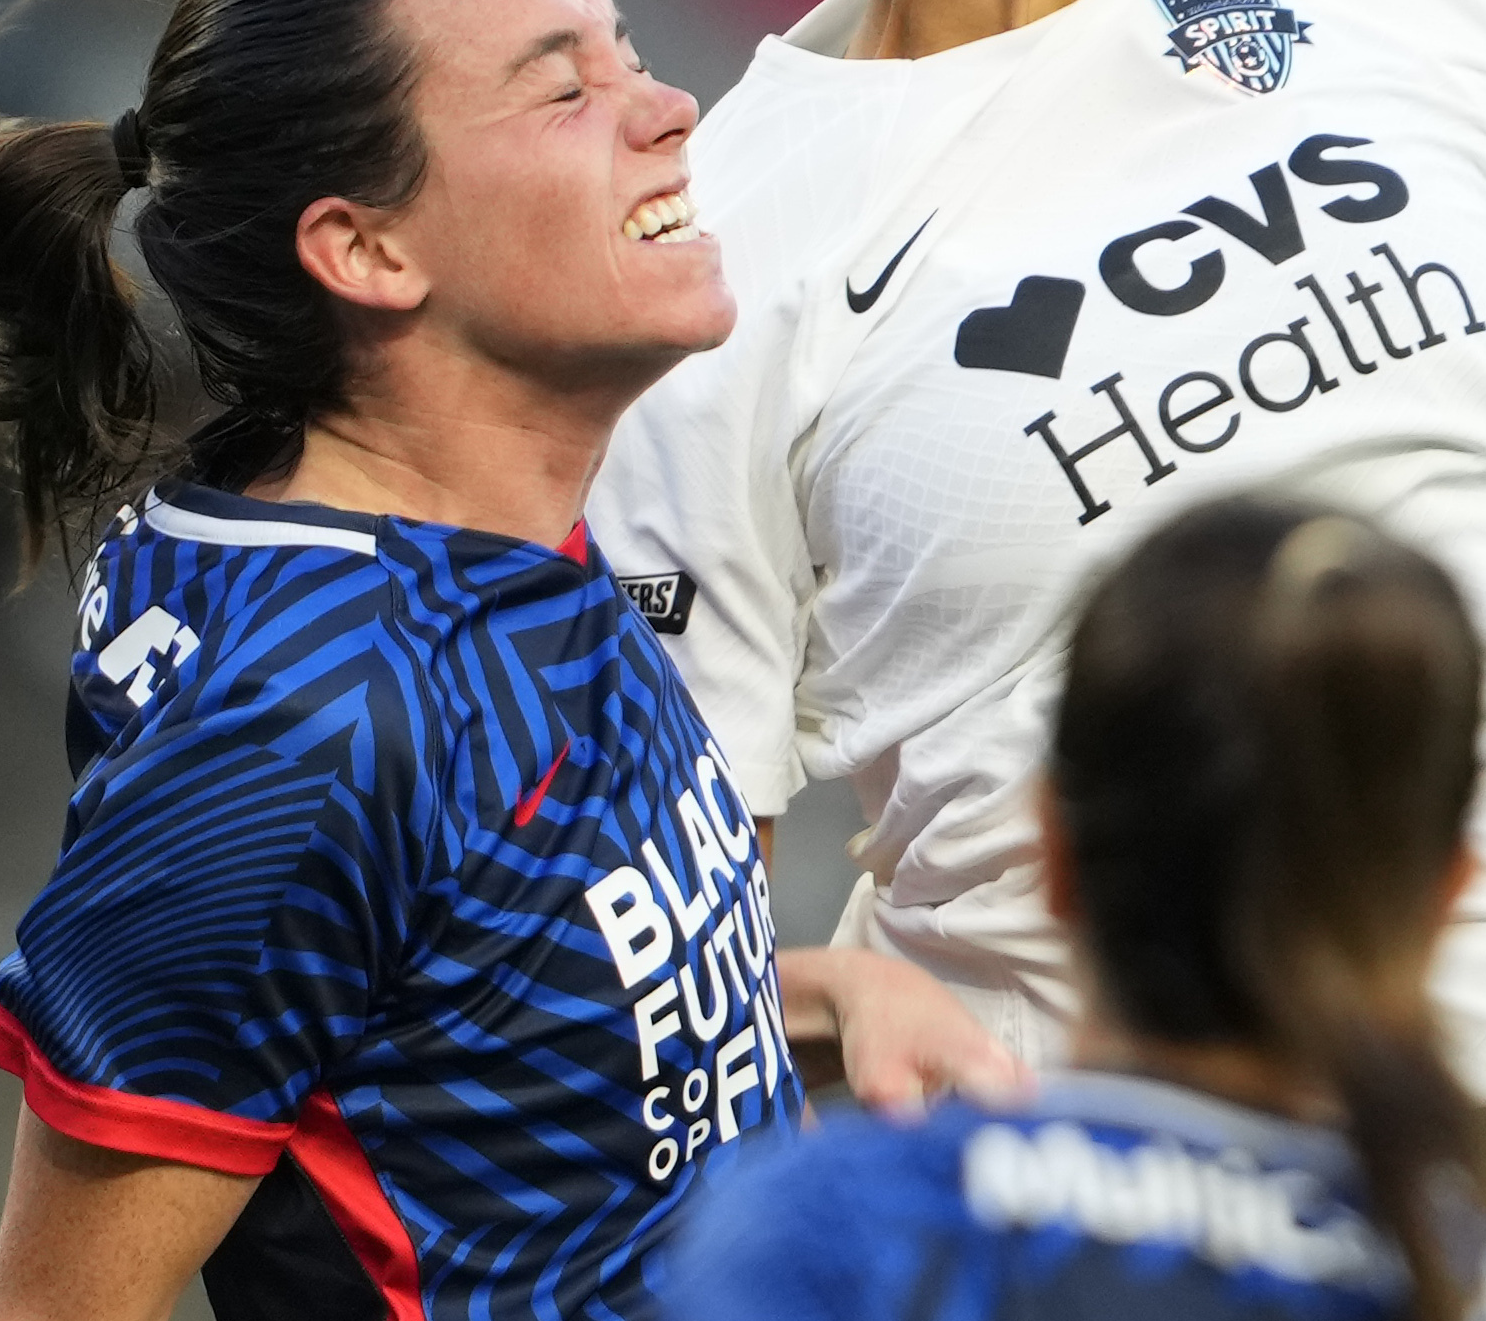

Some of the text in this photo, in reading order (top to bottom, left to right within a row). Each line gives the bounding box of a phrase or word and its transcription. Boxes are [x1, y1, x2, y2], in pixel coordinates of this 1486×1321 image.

[1185, 10, 1275, 47] SPIRIT
[1099, 134, 1409, 316] CVS
[1023, 243, 1486, 526] Health
[622, 581, 674, 614] ERS
